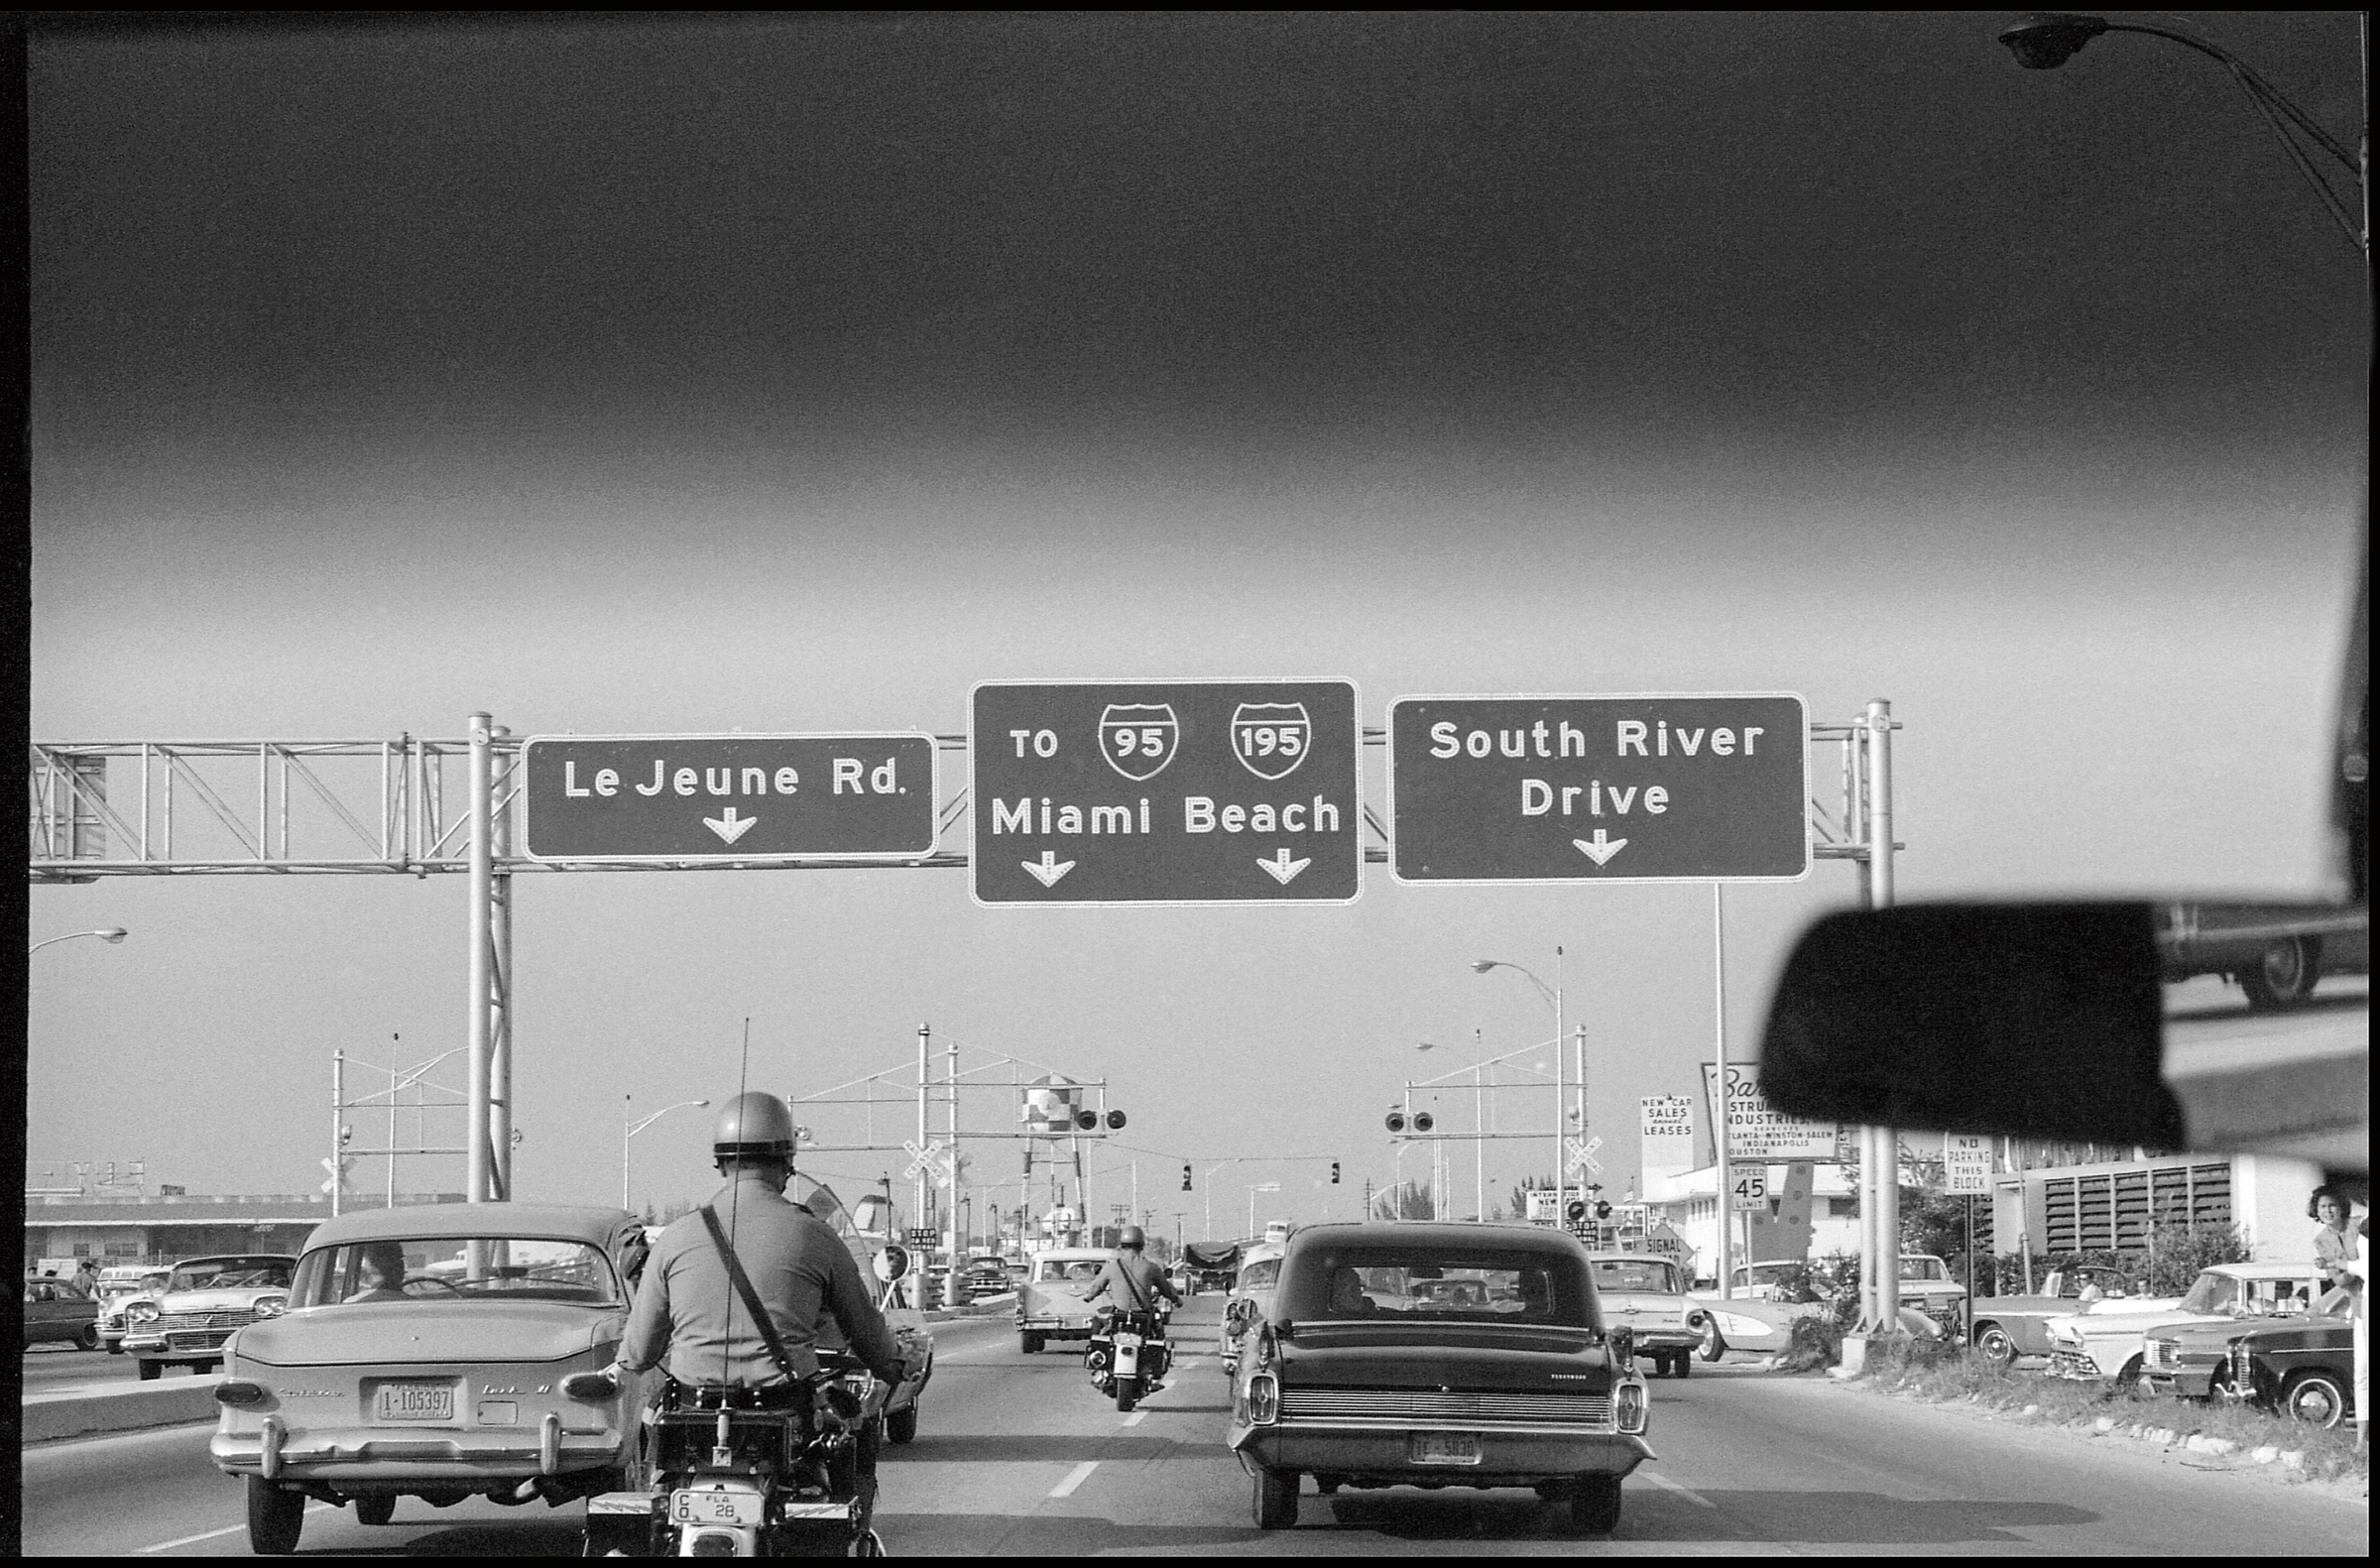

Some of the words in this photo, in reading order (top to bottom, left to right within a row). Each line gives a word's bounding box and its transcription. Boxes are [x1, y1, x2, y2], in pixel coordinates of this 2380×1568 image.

[1011, 730, 1057, 757] TO
[1115, 727, 1163, 757] 95
[1242, 727, 1302, 757] 195
[1430, 721, 1586, 758] South
[1617, 720, 1764, 757] River
[566, 761, 619, 796] Le
[636, 759, 799, 796] Jeune
[833, 758, 906, 794] Rd.
[1522, 780, 1669, 815] Drive
[993, 797, 1150, 834] Miami
[1185, 794, 1340, 833] Beach
[1672, 1098, 1692, 1107] CAR
[1648, 1108, 1687, 1117] SALES
[1644, 1126, 1692, 1135] LEASES
[1959, 1139, 1978, 1148] NO
[1949, 1151, 1989, 1163] PARKING
[1735, 1178, 1764, 1198] 45
[1954, 1177, 1985, 1189] BLOCK
[1647, 1239, 1681, 1253] SIGNAL
[385, 1391, 449, 1410] 1-105397
[715, 1505, 734, 1517] 28
